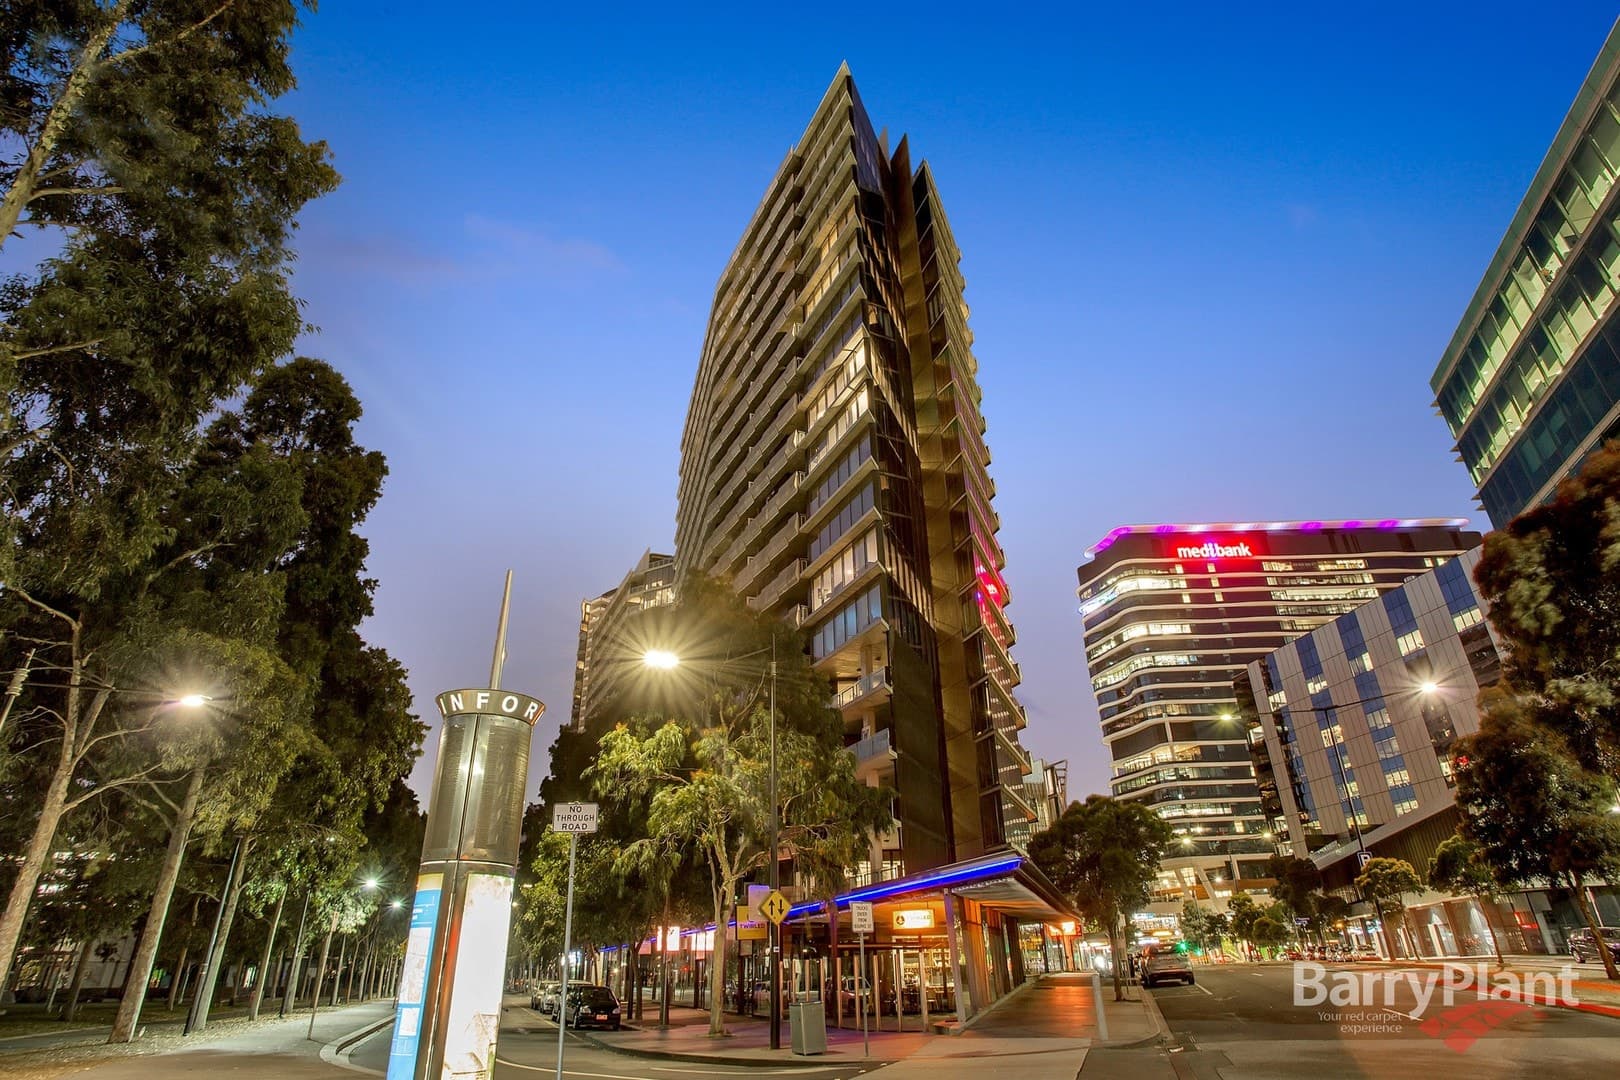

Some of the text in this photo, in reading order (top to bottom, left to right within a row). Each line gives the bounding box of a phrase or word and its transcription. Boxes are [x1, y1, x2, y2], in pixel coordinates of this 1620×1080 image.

[1177, 542, 1252, 558] medibank
[556, 814, 595, 822] THROUGH
[561, 823, 588, 831] ROAD
